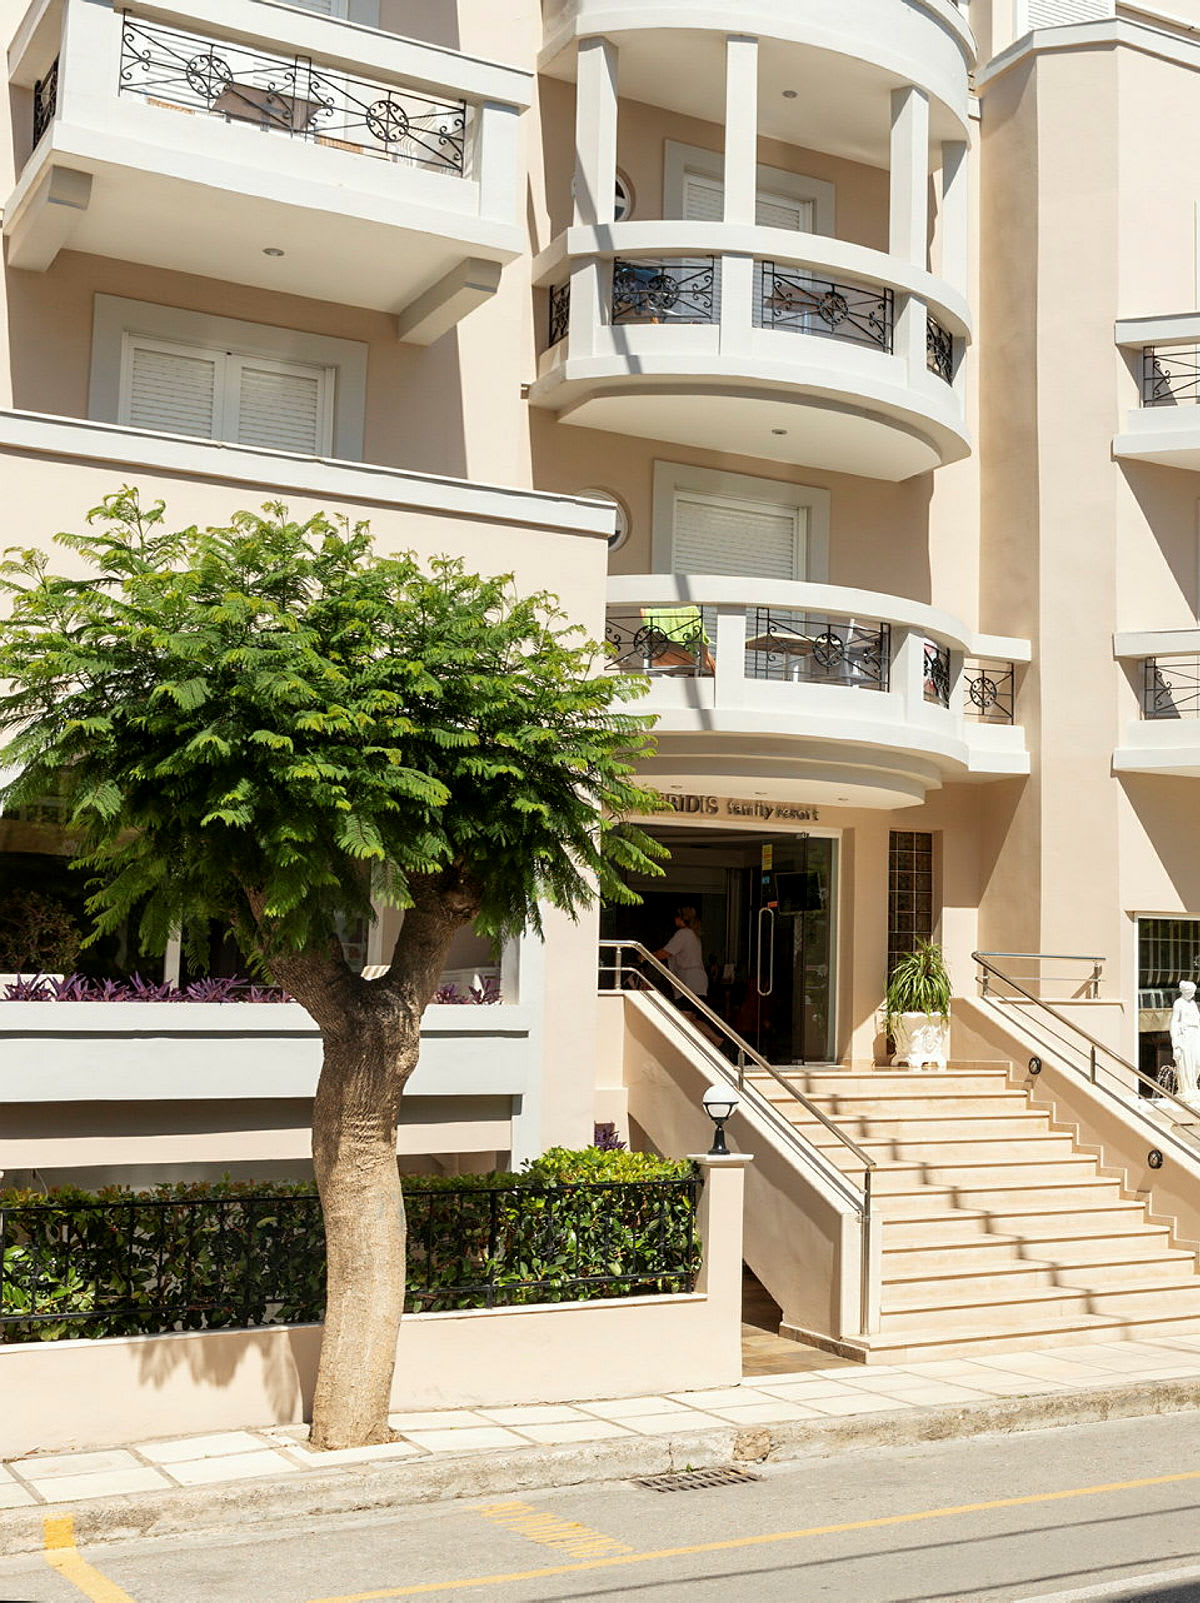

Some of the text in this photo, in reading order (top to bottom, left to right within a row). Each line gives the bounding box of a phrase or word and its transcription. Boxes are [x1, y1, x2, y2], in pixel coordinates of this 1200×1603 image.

[657, 792, 819, 821] RIDIS family resort
